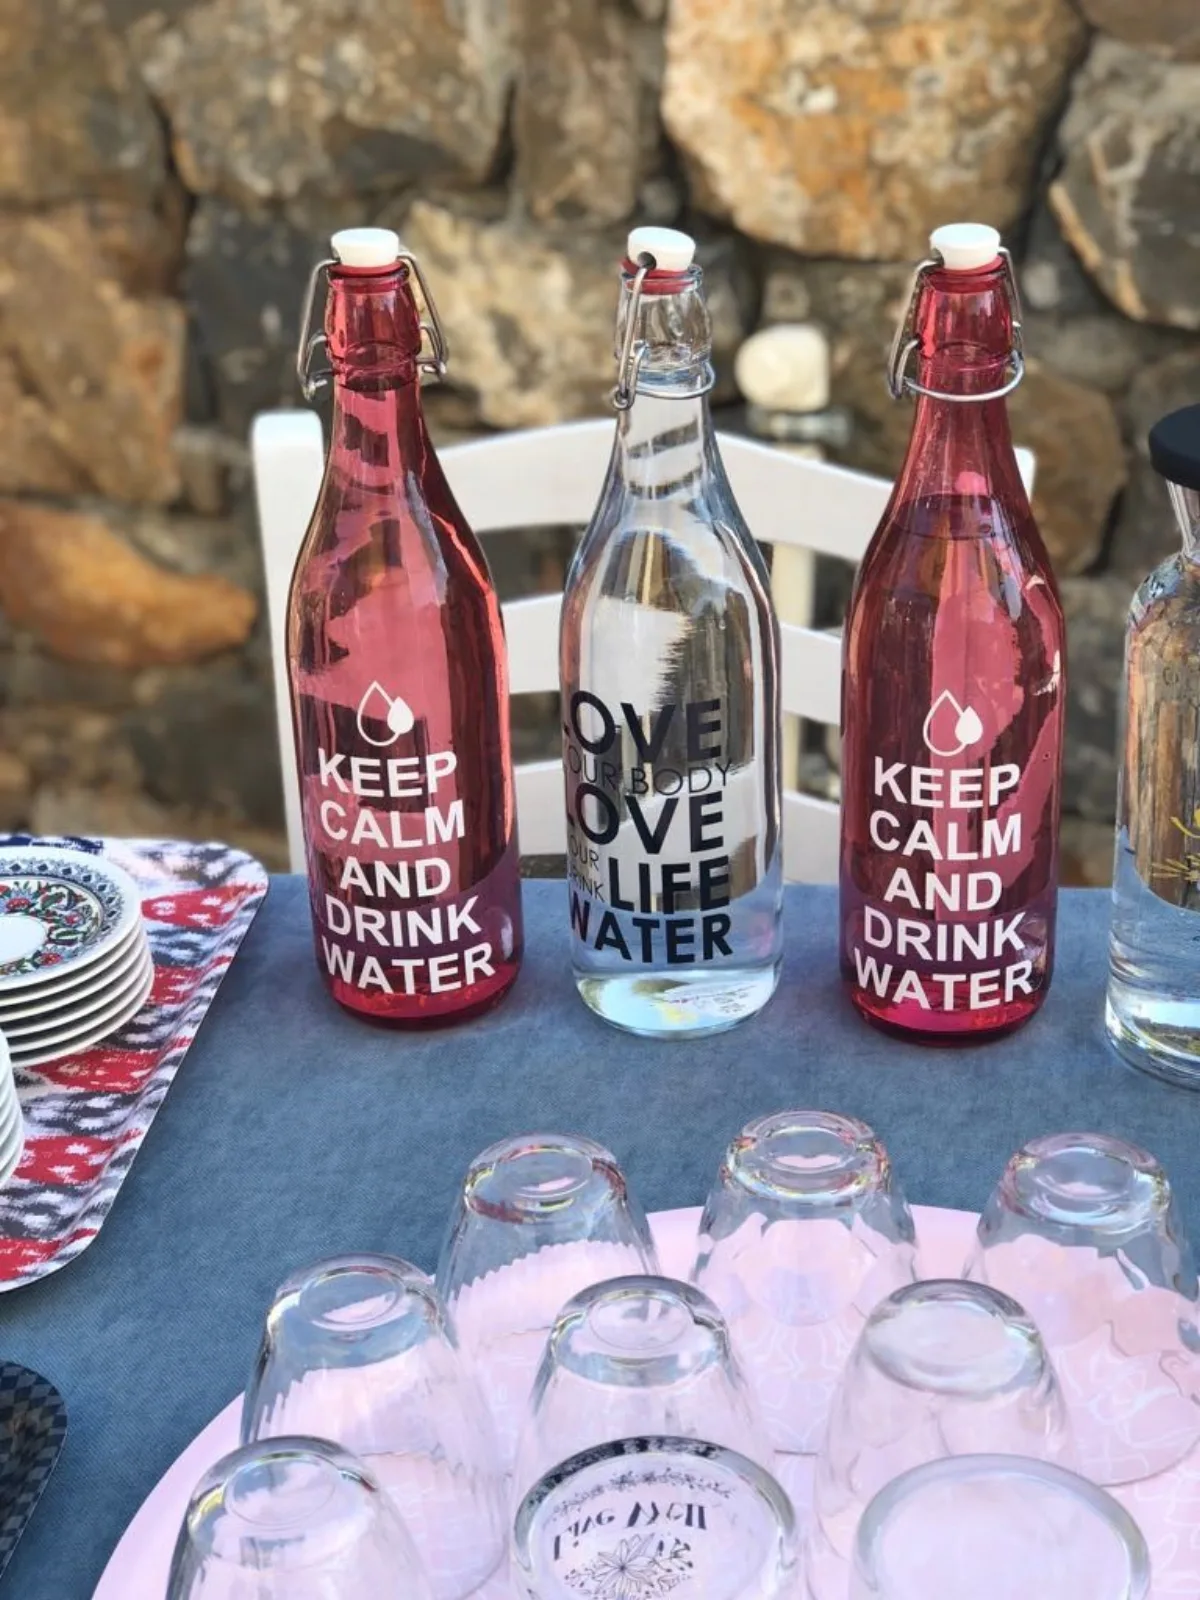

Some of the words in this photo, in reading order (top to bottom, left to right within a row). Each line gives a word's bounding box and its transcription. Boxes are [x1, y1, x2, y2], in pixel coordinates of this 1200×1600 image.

[564, 690, 721, 763] OVE
[318, 748, 457, 798] KEEP
[567, 745, 619, 790] OUR
[631, 759, 732, 796] BODY
[874, 756, 1020, 809] KEEP
[320, 800, 465, 849] CALM
[566, 783, 724, 855] OVE
[870, 810, 1022, 861] CALM
[340, 856, 451, 899] AND
[568, 835, 600, 872] OUR
[608, 855, 731, 915] LIFE
[883, 867, 1003, 912] AND
[325, 894, 482, 948] DRINK
[864, 905, 1027, 962] DRINK
[322, 934, 496, 996] WATER
[854, 946, 1033, 1012] WATER
